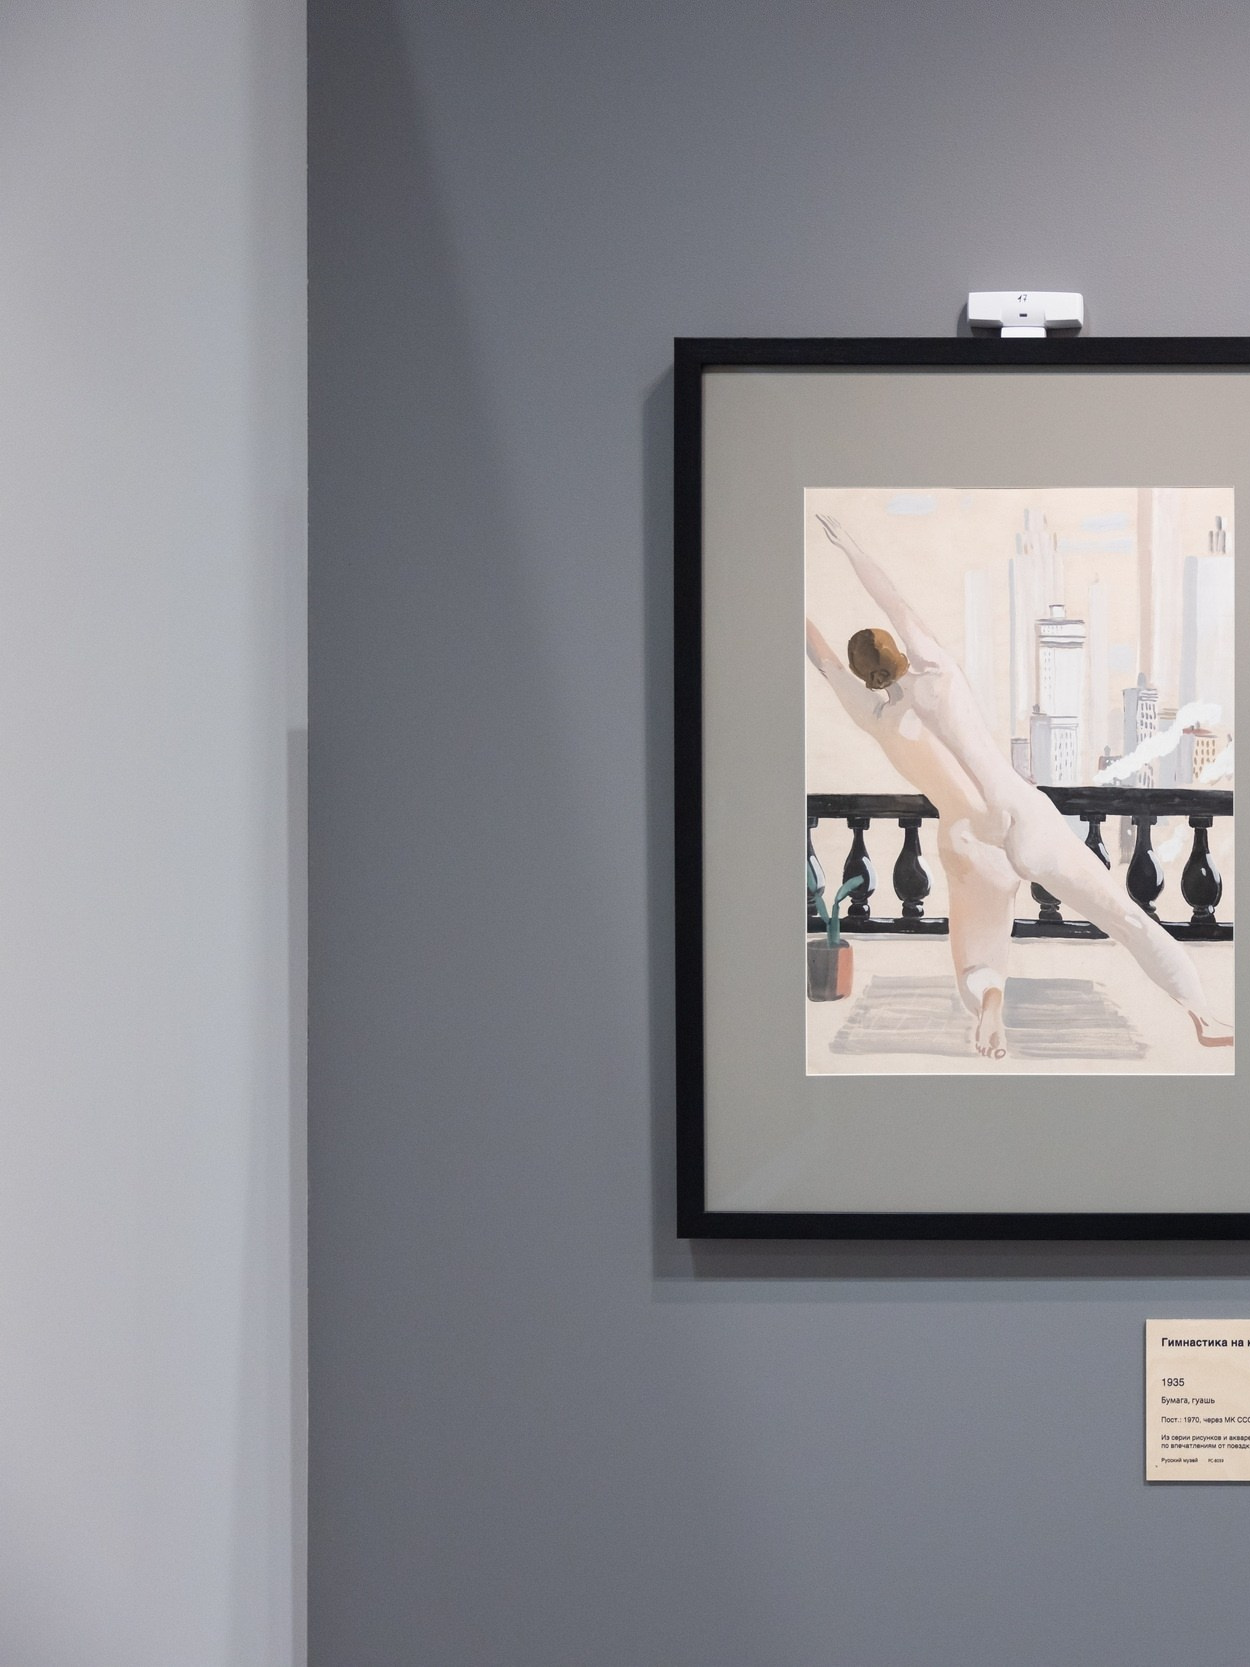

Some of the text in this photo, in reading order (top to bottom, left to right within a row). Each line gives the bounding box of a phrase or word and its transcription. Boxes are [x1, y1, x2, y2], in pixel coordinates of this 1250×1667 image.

[1161, 1337, 1228, 1348] Гимнастика
[1231, 1339, 1245, 1348] на
[1161, 1377, 1185, 1387] 1935
[1161, 1396, 1190, 1405] Бумага,
[1183, 1416, 1202, 1425] 1970,
[1224, 1416, 1236, 1424] МК
